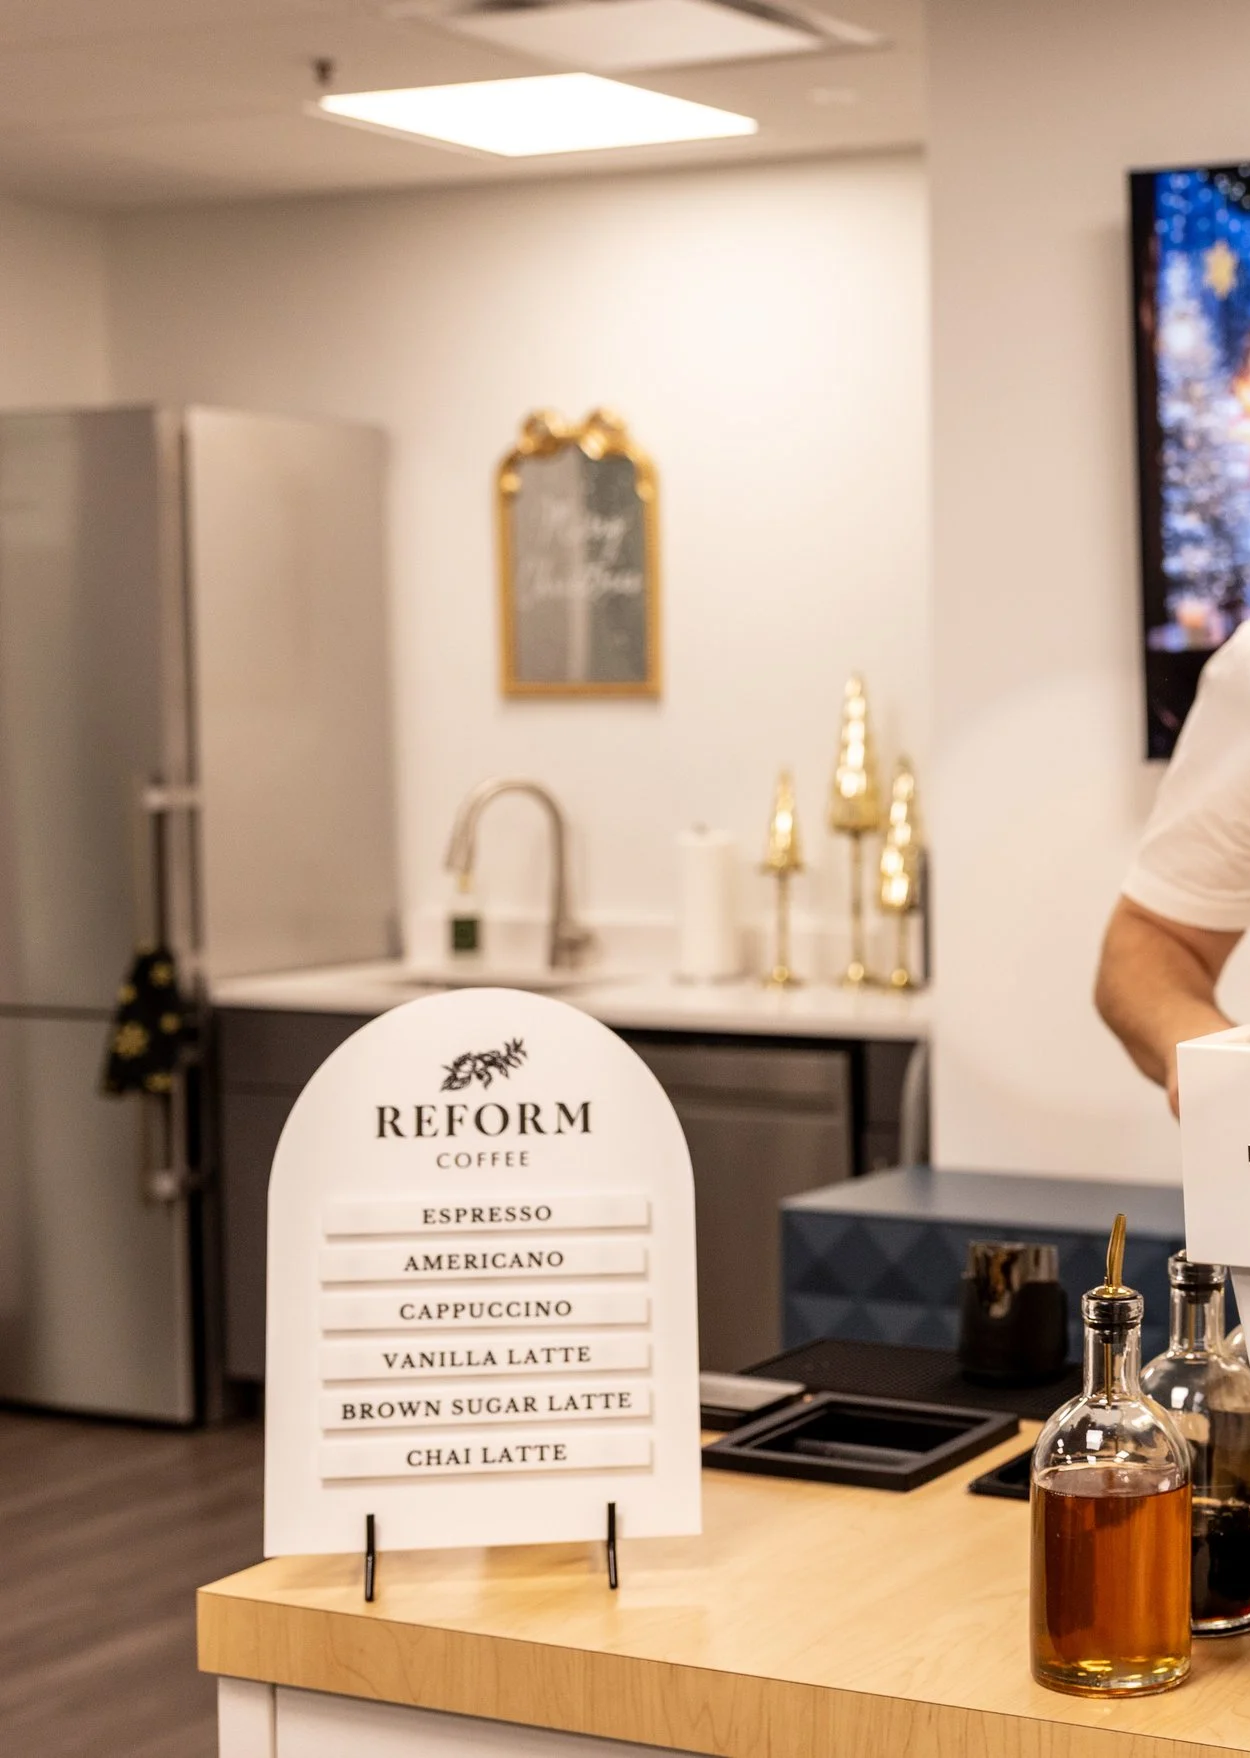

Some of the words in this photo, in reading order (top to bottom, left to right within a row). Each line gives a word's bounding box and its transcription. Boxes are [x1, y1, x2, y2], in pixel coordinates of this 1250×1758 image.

[376, 1100, 592, 1139] REFORM
[436, 1150, 530, 1169] COFFEE
[422, 1205, 552, 1225] ESPRESSO
[403, 1251, 564, 1272] AMERICANO
[399, 1300, 572, 1321] CAPPUCCINO
[382, 1349, 497, 1369] VANILLA
[508, 1346, 591, 1366] LATTE
[341, 1399, 442, 1421] BROWN
[451, 1396, 538, 1416] SUGAR
[548, 1391, 632, 1412] LATTE
[406, 1447, 471, 1468] CHAI
[481, 1443, 567, 1464] LATTE
